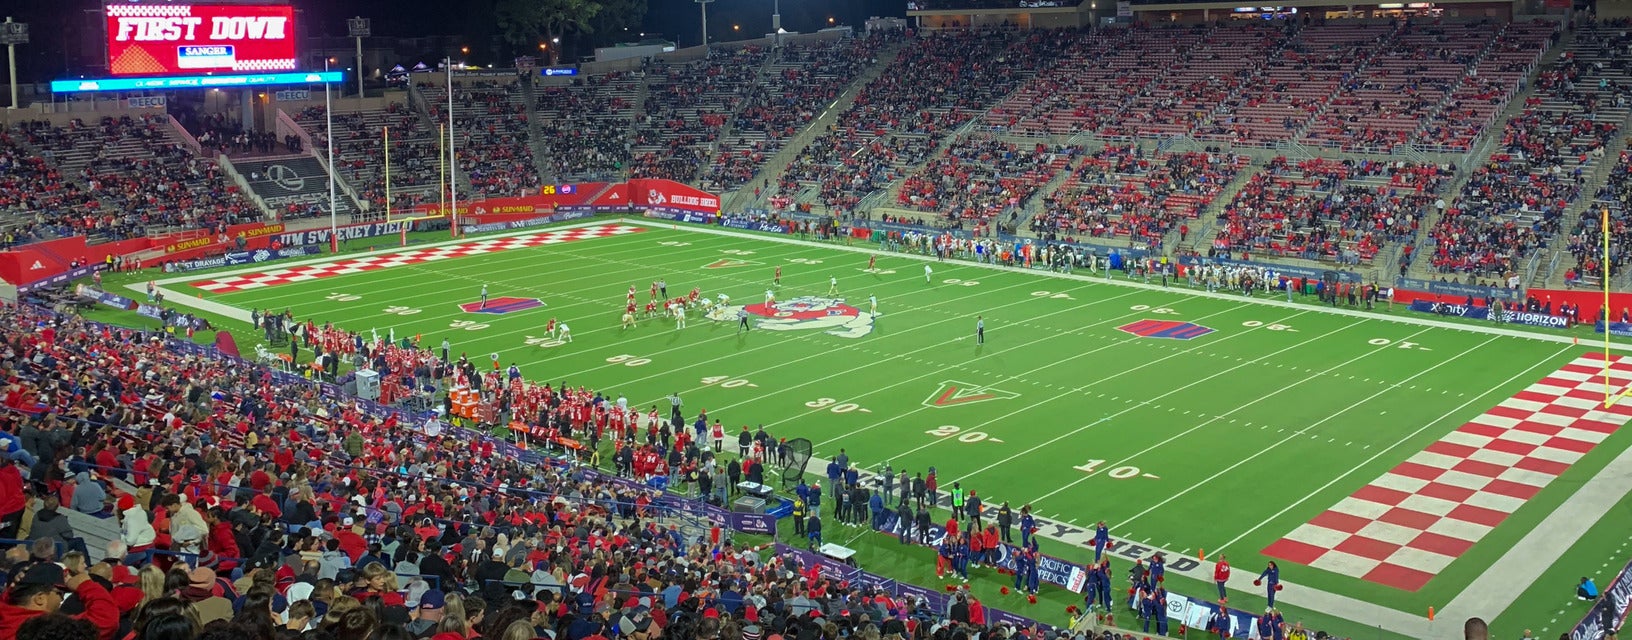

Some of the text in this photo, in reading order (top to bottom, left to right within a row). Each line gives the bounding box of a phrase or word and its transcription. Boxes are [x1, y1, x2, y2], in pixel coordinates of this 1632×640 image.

[115, 16, 287, 41] FIRST DOWN
[185, 47, 228, 56] SANGER
[138, 97, 165, 106] EECU
[285, 91, 309, 99] EECU
[543, 185, 555, 194] 26
[671, 195, 699, 206] BULLDOG
[308, 224, 370, 244] SWENEY
[1516, 312, 1567, 326] HORIZON
[606, 354, 652, 367] 50
[701, 375, 749, 388] 40
[805, 397, 859, 413] 30
[924, 425, 989, 443] 20
[1073, 459, 1140, 479] 10
[1040, 556, 1070, 574] PACIFIC
